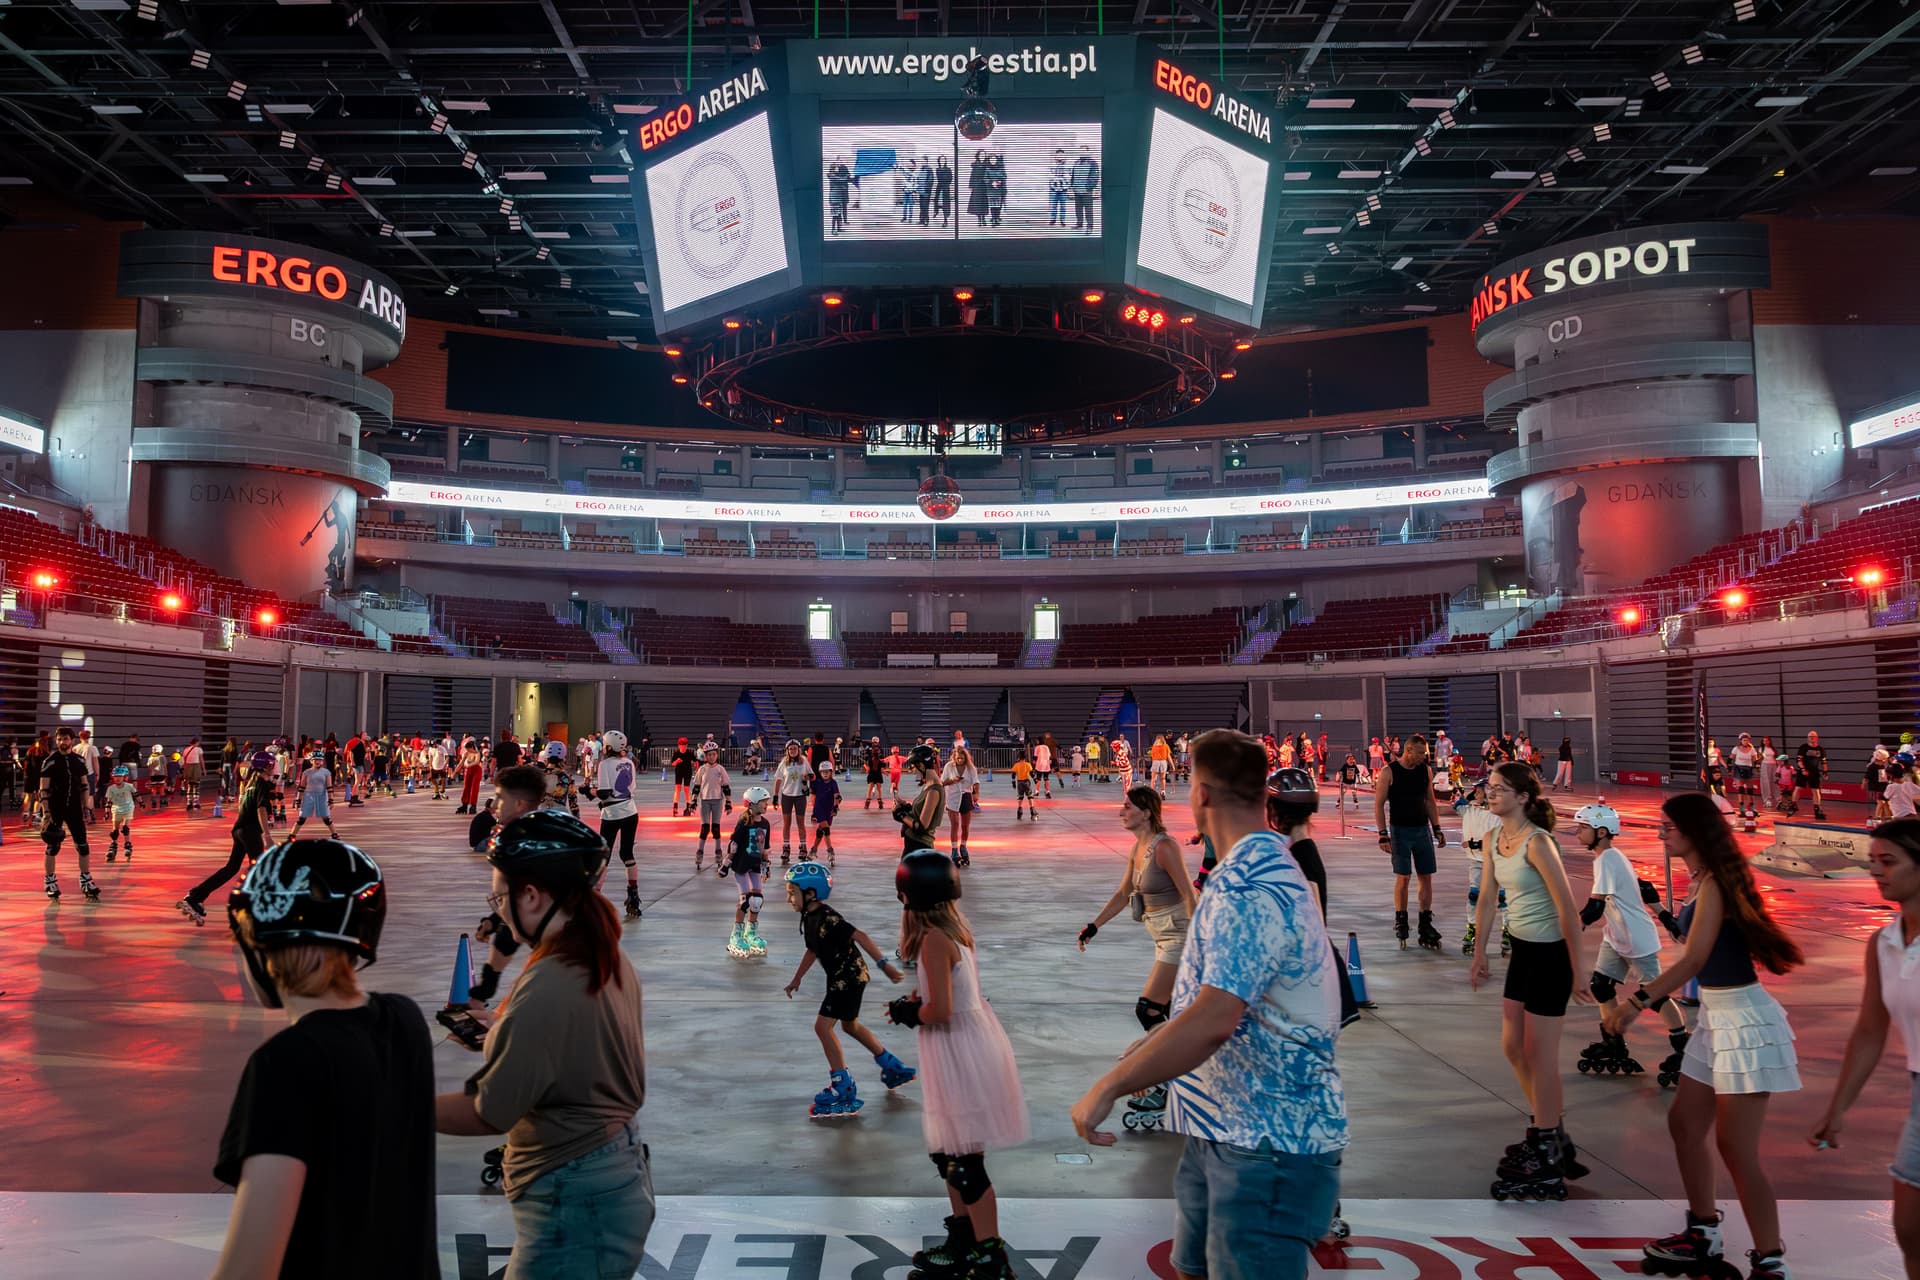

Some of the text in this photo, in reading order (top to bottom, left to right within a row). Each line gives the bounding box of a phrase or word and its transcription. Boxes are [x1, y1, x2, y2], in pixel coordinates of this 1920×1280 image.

[640, 67, 767, 150] ERGO ARENA
[1156, 59, 1271, 144] ERGO ARENA
[714, 196, 736, 214] ERGO
[1208, 201, 1228, 218] ERGO
[717, 209, 741, 227] ARENA
[1206, 216, 1229, 233] ARENA
[213, 246, 347, 300] ERGO
[1544, 239, 1696, 293] SOPOT
[290, 318, 326, 347] BC
[1548, 315, 1583, 343] CD
[430, 491, 502, 503] ERGO ARENA
[1407, 485, 1484, 499] ERGO ARENA
[1607, 477, 1708, 503] GDAŃSK
[575, 501, 645, 512] ERGO ARENA
[1119, 505, 1188, 515] ERGO ARENA
[1260, 497, 1332, 509] ERGO ARENA
[714, 507, 781, 517] ERGO ARENA
[850, 510, 915, 519] ERGO ARENA
[984, 509, 1050, 518] ERGO ARENA
